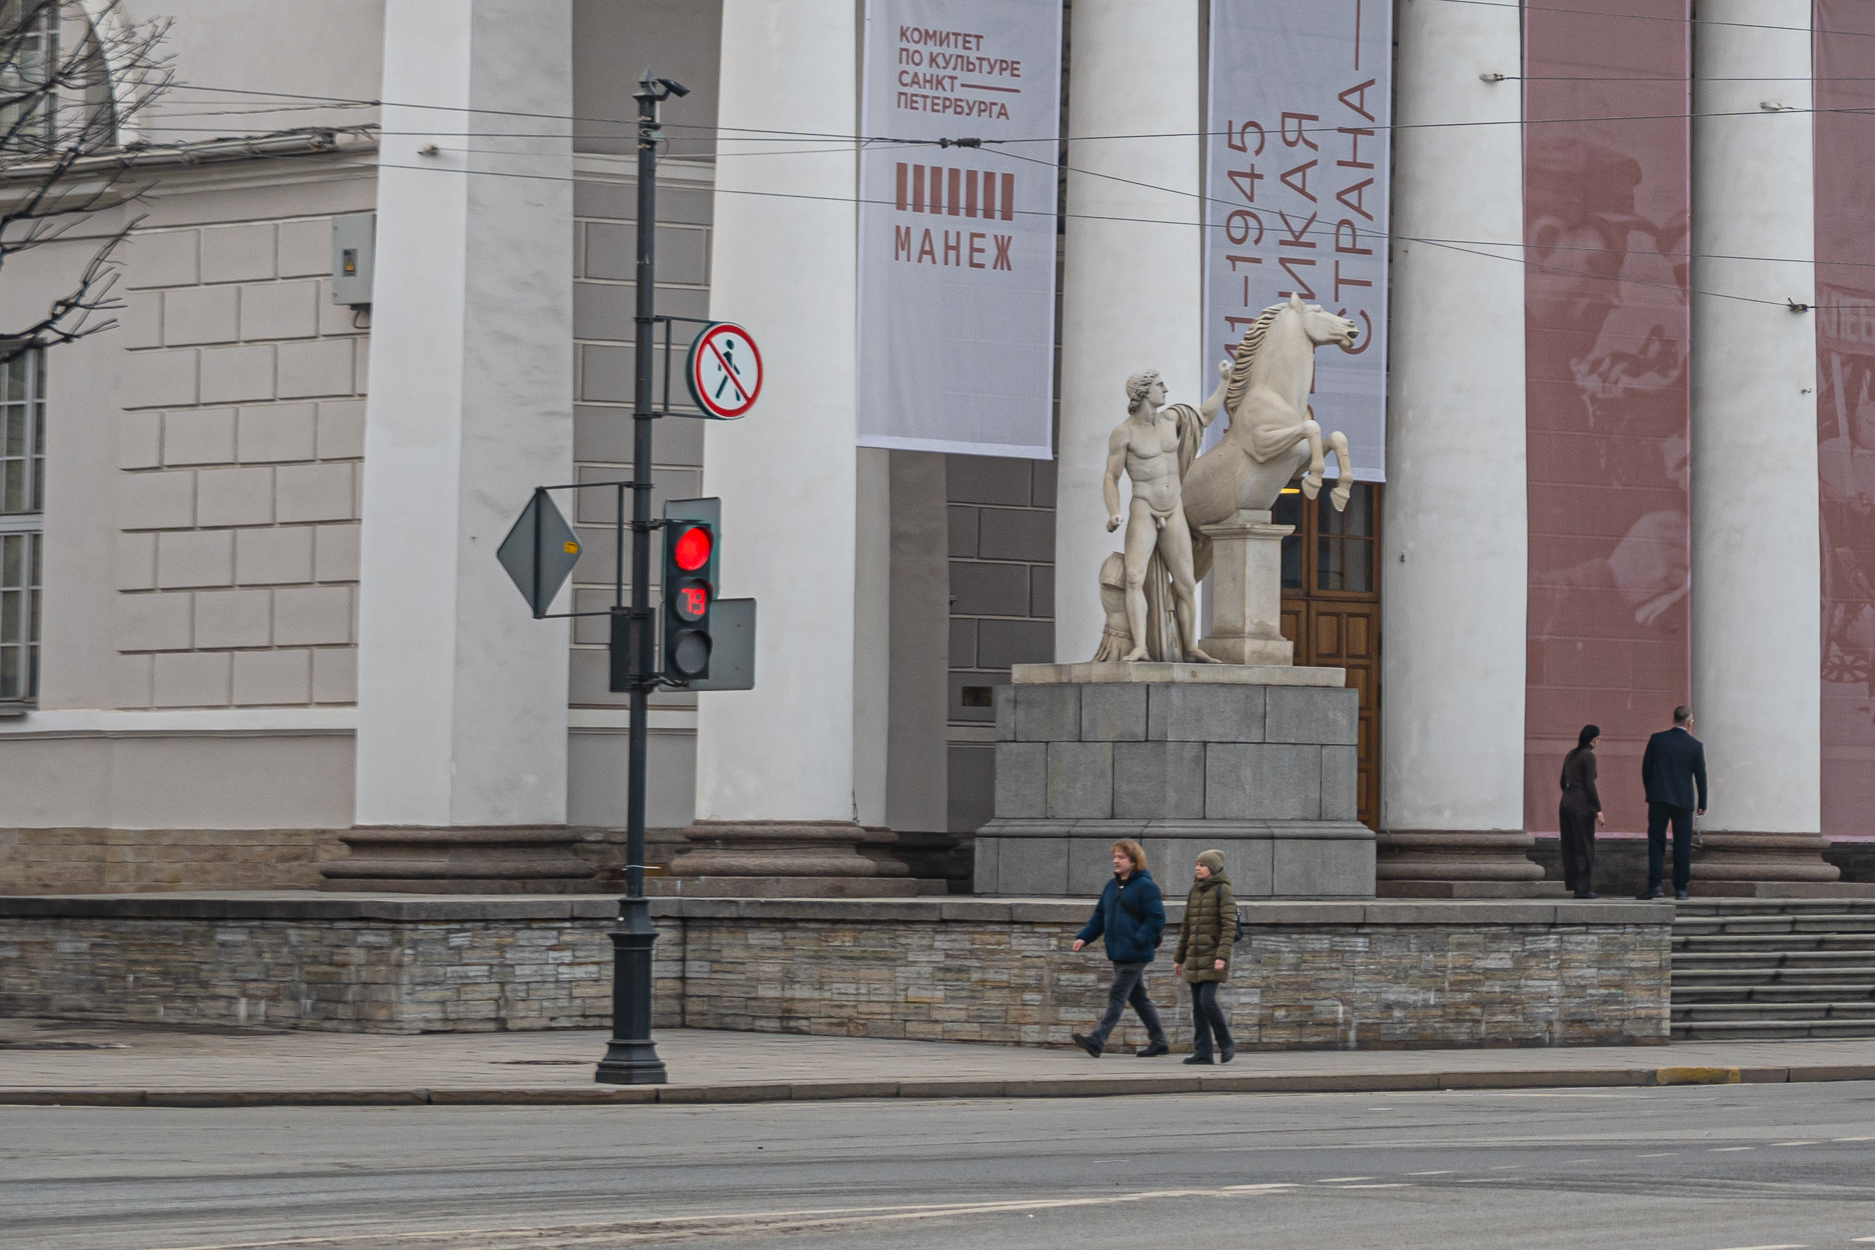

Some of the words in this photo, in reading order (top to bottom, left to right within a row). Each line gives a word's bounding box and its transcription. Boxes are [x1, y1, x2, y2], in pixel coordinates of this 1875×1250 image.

[899, 24, 985, 52] КОМИТЕТ
[898, 47, 924, 67] ПО
[929, 51, 1021, 78] КУЛЬТУРЕ
[896, 91, 1011, 120] ПЕТЕРБУРГА
[1334, 78, 1376, 355] СТРАНА
[894, 224, 1013, 271] МАНЕЖ
[1277, 111, 1320, 421] ИКАЯ
[681, 588, 705, 615] 79
